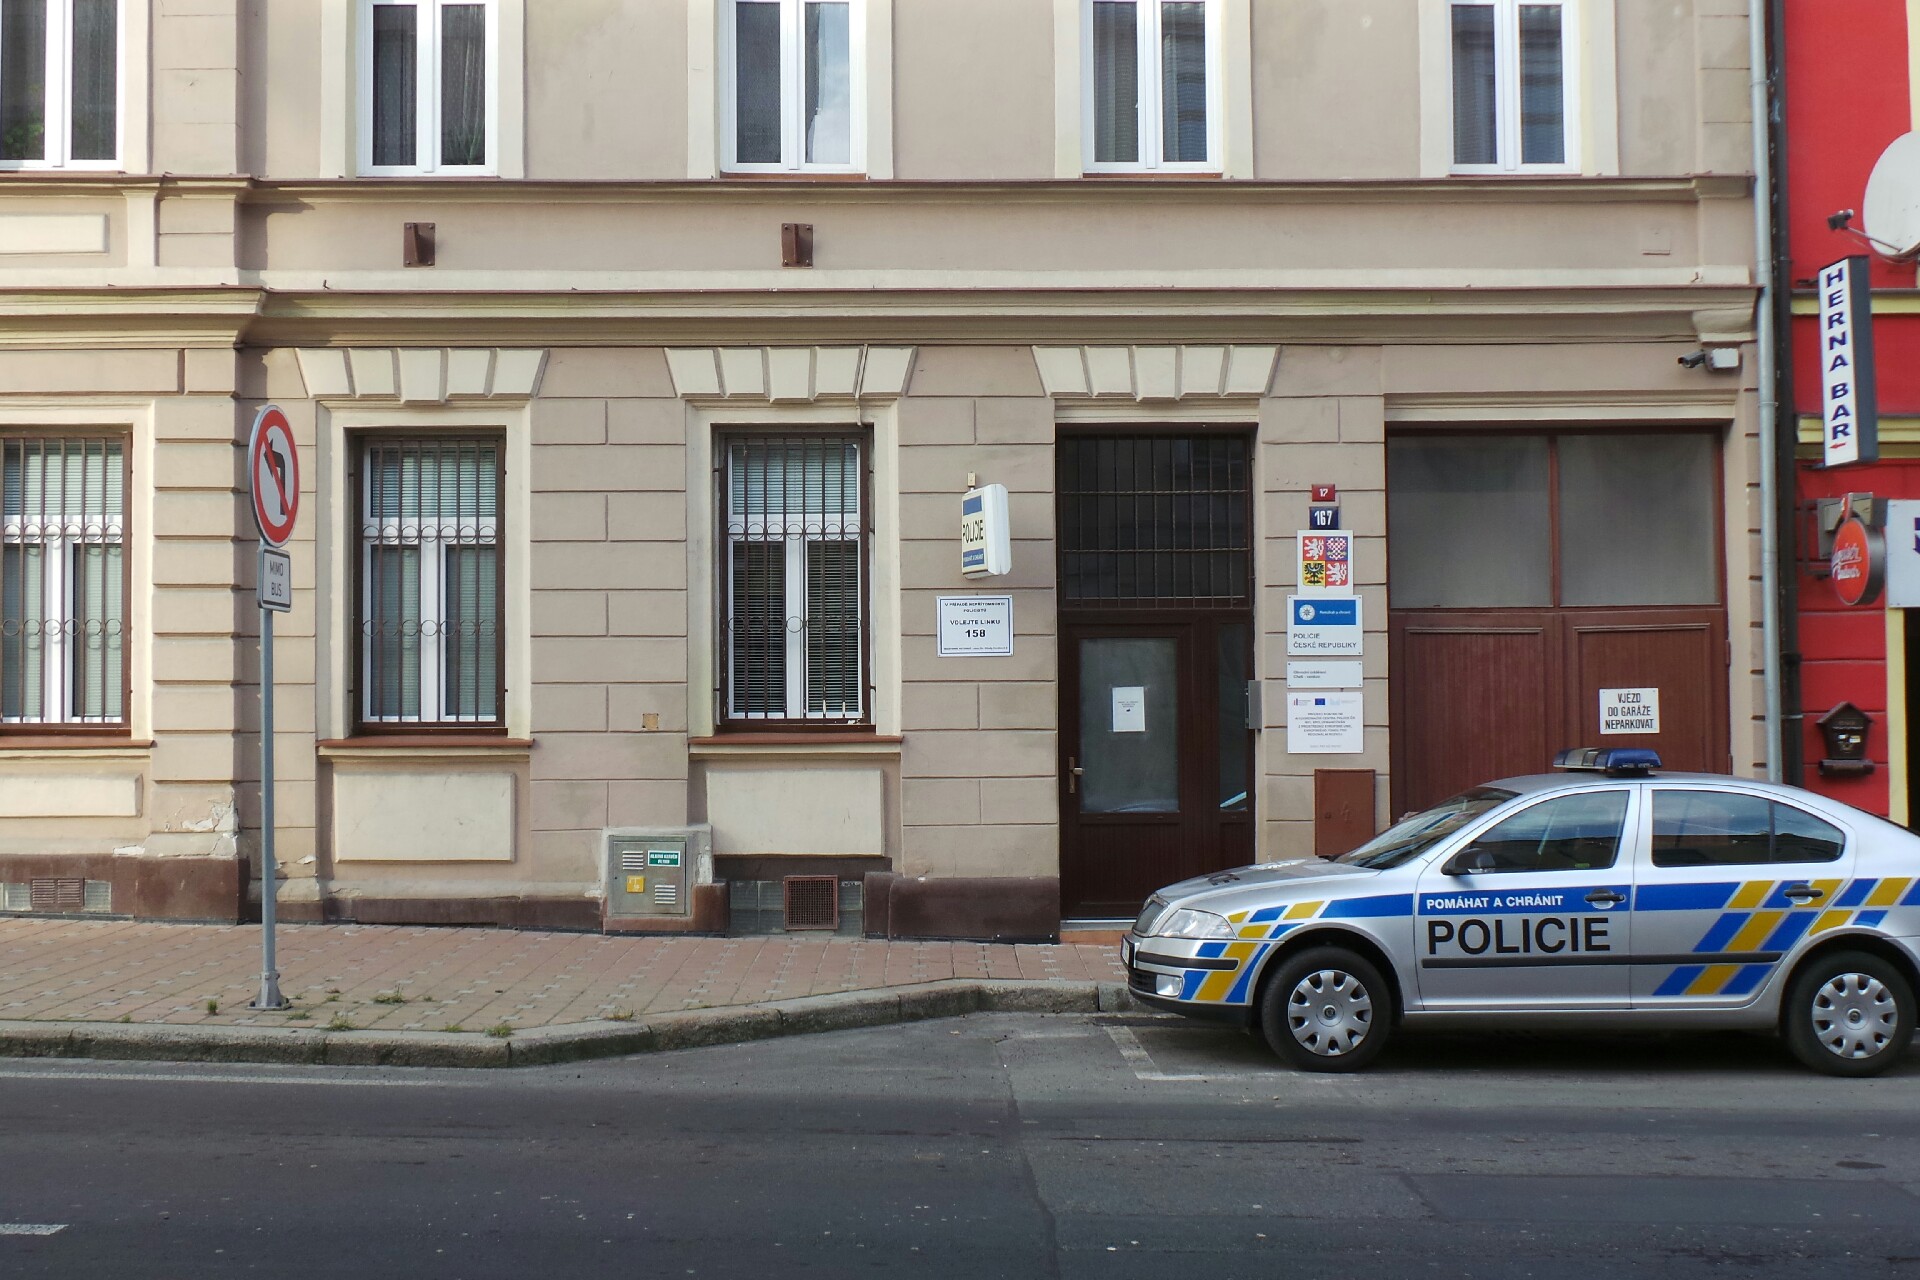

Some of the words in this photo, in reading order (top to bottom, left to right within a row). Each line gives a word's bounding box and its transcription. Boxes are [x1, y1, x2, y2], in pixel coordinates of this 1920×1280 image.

[1825, 267, 1849, 372] HERNA
[1830, 382, 1851, 440] BAR
[1319, 488, 1329, 498] 17
[1314, 510, 1333, 526] 167
[271, 582, 282, 597] BUS
[965, 629, 986, 638] 158
[1293, 632, 1320, 640] POLICIE
[1617, 692, 1641, 704] VJEZD
[1607, 706, 1619, 717] DO
[1621, 705, 1651, 716] GARÁŽE
[1605, 718, 1655, 730] NEPARKOVAT
[1426, 895, 1489, 910] POMÁHAT
[1493, 896, 1503, 908] A
[1506, 893, 1564, 907] CHRÁNIT
[1427, 917, 1611, 955] POLICIE
